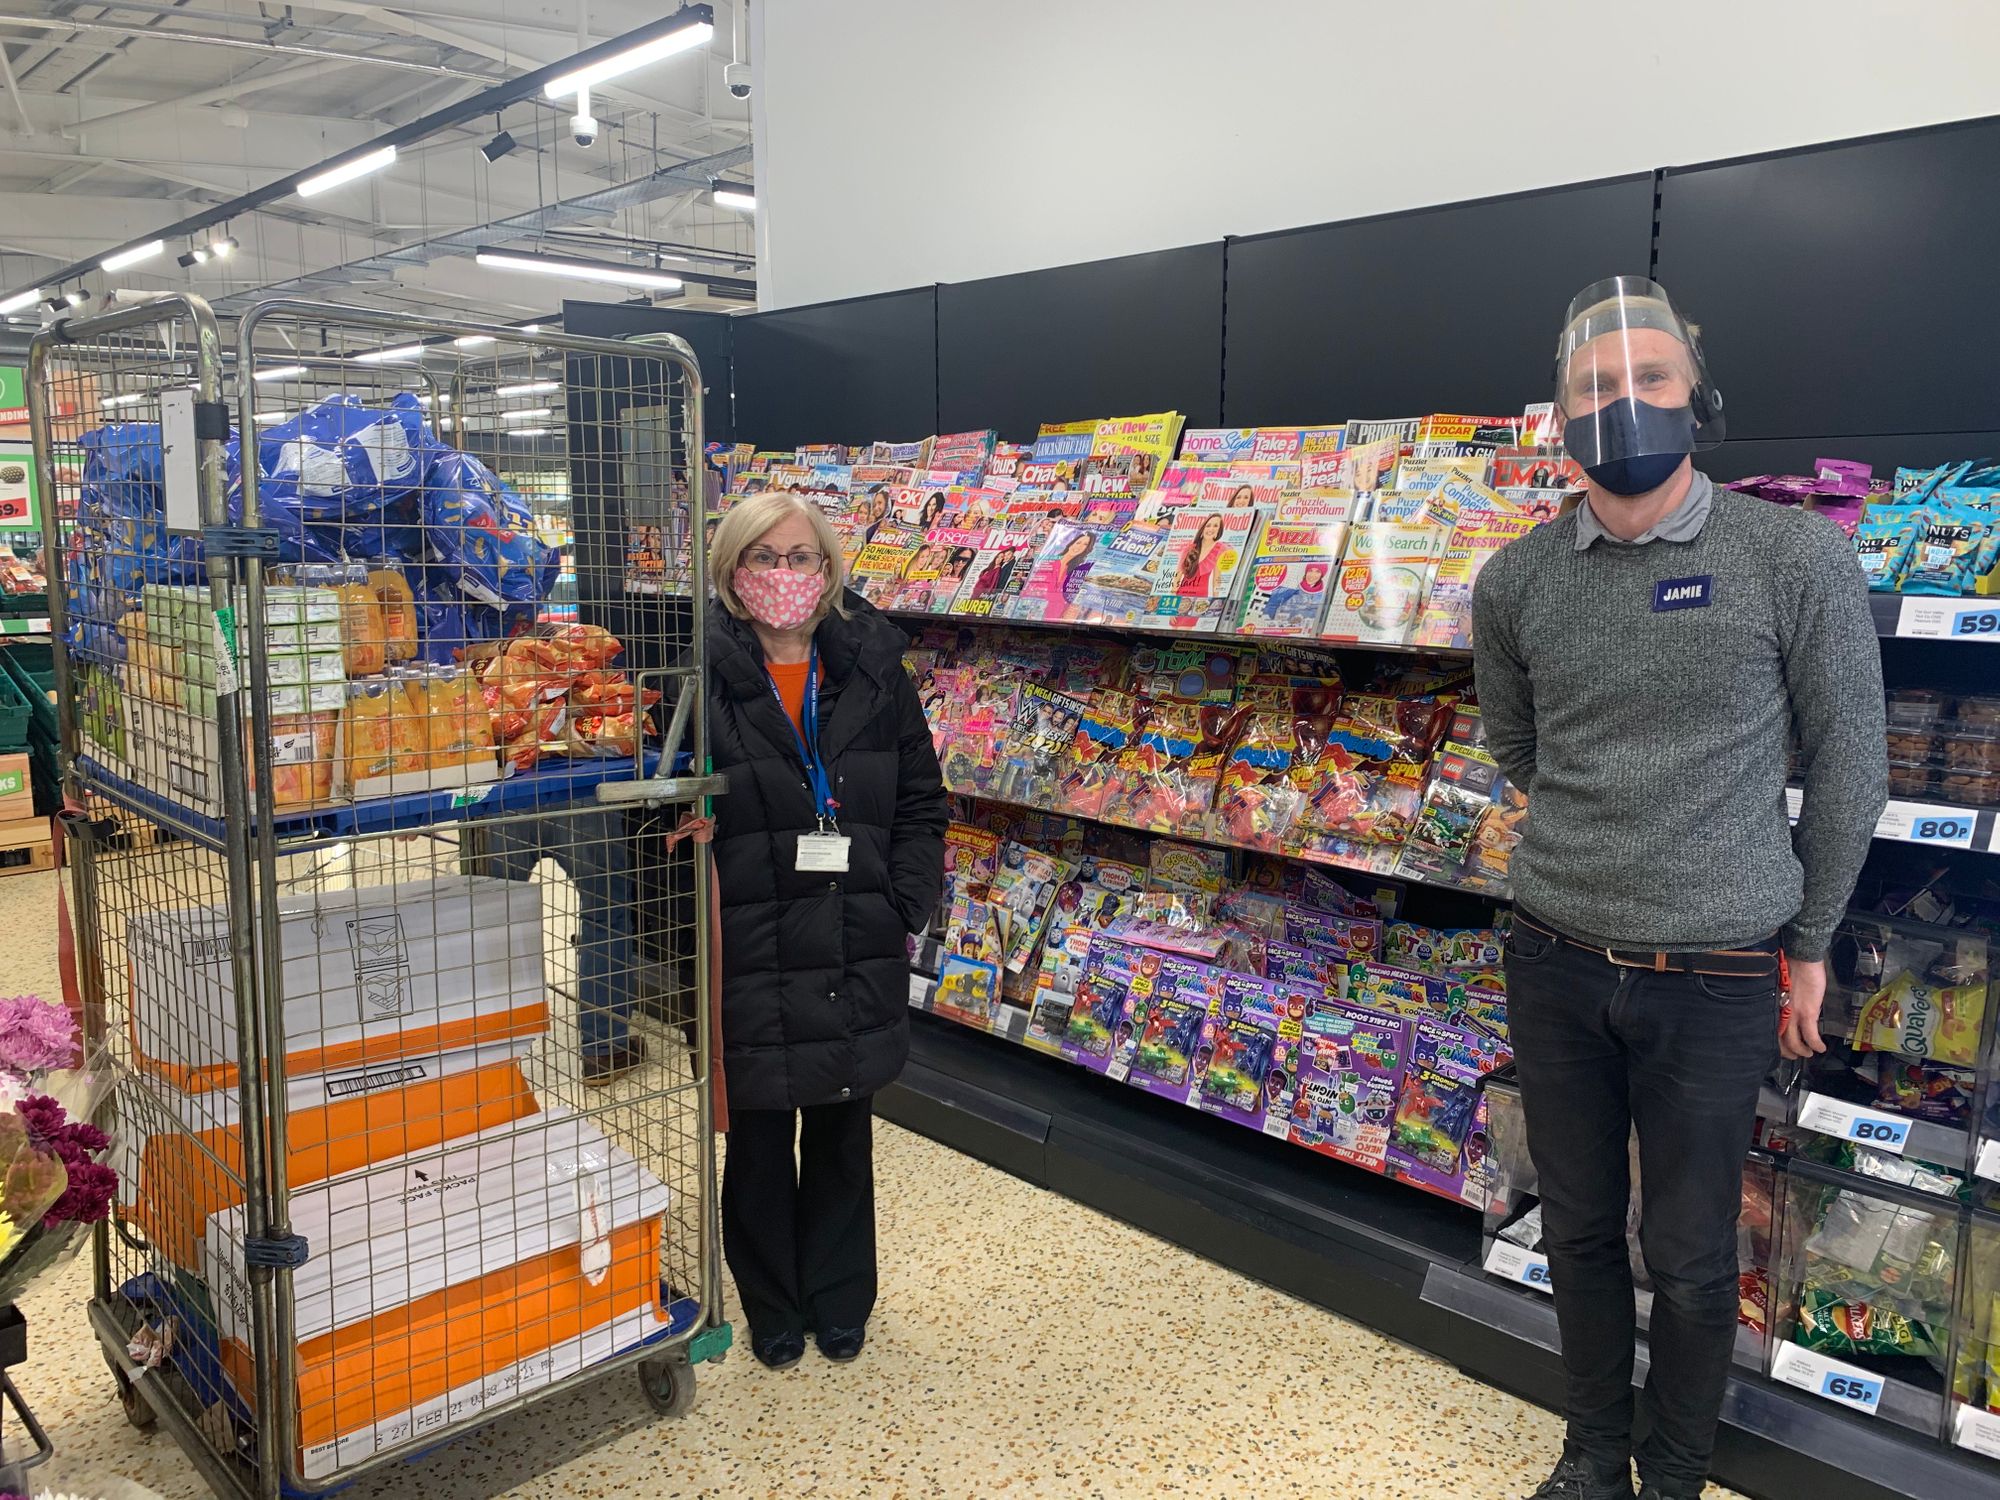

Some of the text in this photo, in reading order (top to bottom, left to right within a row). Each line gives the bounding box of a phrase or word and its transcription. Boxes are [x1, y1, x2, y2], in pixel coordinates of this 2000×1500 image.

[1461, 417, 1492, 425] BRISTOL
[1494, 418, 1503, 426] IS
[1256, 437, 1298, 451] Take a
[1022, 465, 1058, 484] Chat
[796, 490, 841, 507] RadioTime
[897, 490, 926, 507] OK!
[1253, 484, 1284, 503] World
[1296, 497, 1325, 507] Puzzle
[1280, 504, 1345, 519] Compendium
[1226, 513, 1253, 532] World
[1451, 531, 1512, 548] Crosswo
[1928, 525, 1970, 543] NUTS
[1110, 537, 1154, 556] Friend
[1268, 545, 1309, 555] Collection
[1386, 536, 1429, 550] Search
[1859, 538, 1899, 548] NUTS
[865, 544, 914, 557] SO HUNGOVER
[1445, 550, 1471, 559] WITH
[859, 561, 873, 569] THE
[866, 554, 881, 562] WAS
[1663, 585, 1703, 602] JAMIE
[953, 598, 993, 616] LAUREN
[1033, 688, 1053, 702] MEGA
[1051, 693, 1071, 709] GIFTS
[1450, 743, 1478, 758] SPECIAL
[954, 897, 970, 908] FREE
[1069, 938, 1088, 949] THOM
[1391, 970, 1410, 981] HERO
[1409, 974, 1424, 982] GIFT
[1345, 1010, 1401, 1030] ON SALE SOON
[1441, 1030, 1464, 1043] SPACE
[1419, 1070, 1430, 1082] 3
[1356, 1142, 1382, 1154] HERO
[1356, 1153, 1379, 1167] NEXT
[391, 1424, 409, 1441] 27
[416, 1413, 443, 1430] FEB
[449, 1401, 464, 1417] 21
[310, 1446, 326, 1456] BEST
